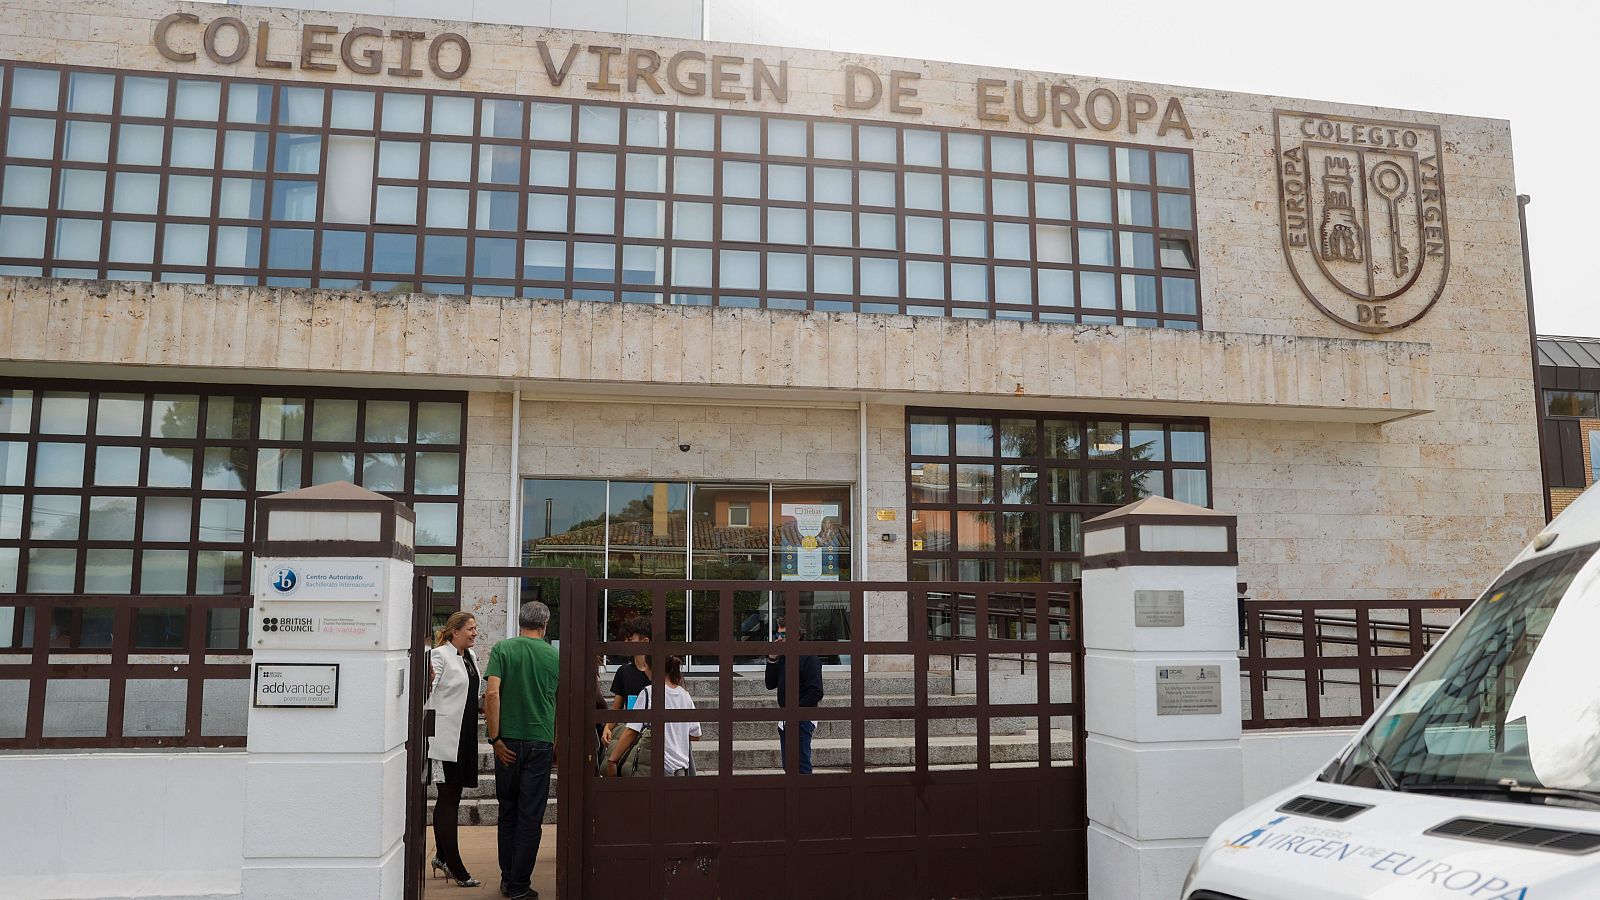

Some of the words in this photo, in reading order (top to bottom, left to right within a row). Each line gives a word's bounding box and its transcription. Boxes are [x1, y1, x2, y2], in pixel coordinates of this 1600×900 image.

[153, 12, 472, 81] COLEGIO
[535, 40, 788, 104] VIRGEN
[845, 64, 923, 115] DE
[976, 77, 1195, 140] EUROPA
[1299, 118, 1418, 149] COLEGIO
[1282, 146, 1308, 248] EUROPA
[1419, 154, 1444, 257] VIRGEN
[1356, 303, 1389, 325] DE
[280, 617, 313, 625] BRITISH
[262, 682, 331, 696] addvantage
[1257, 832, 1364, 862] VIRGEN
[1359, 846, 1387, 859] DE
[1370, 851, 1529, 900] EUROPA
